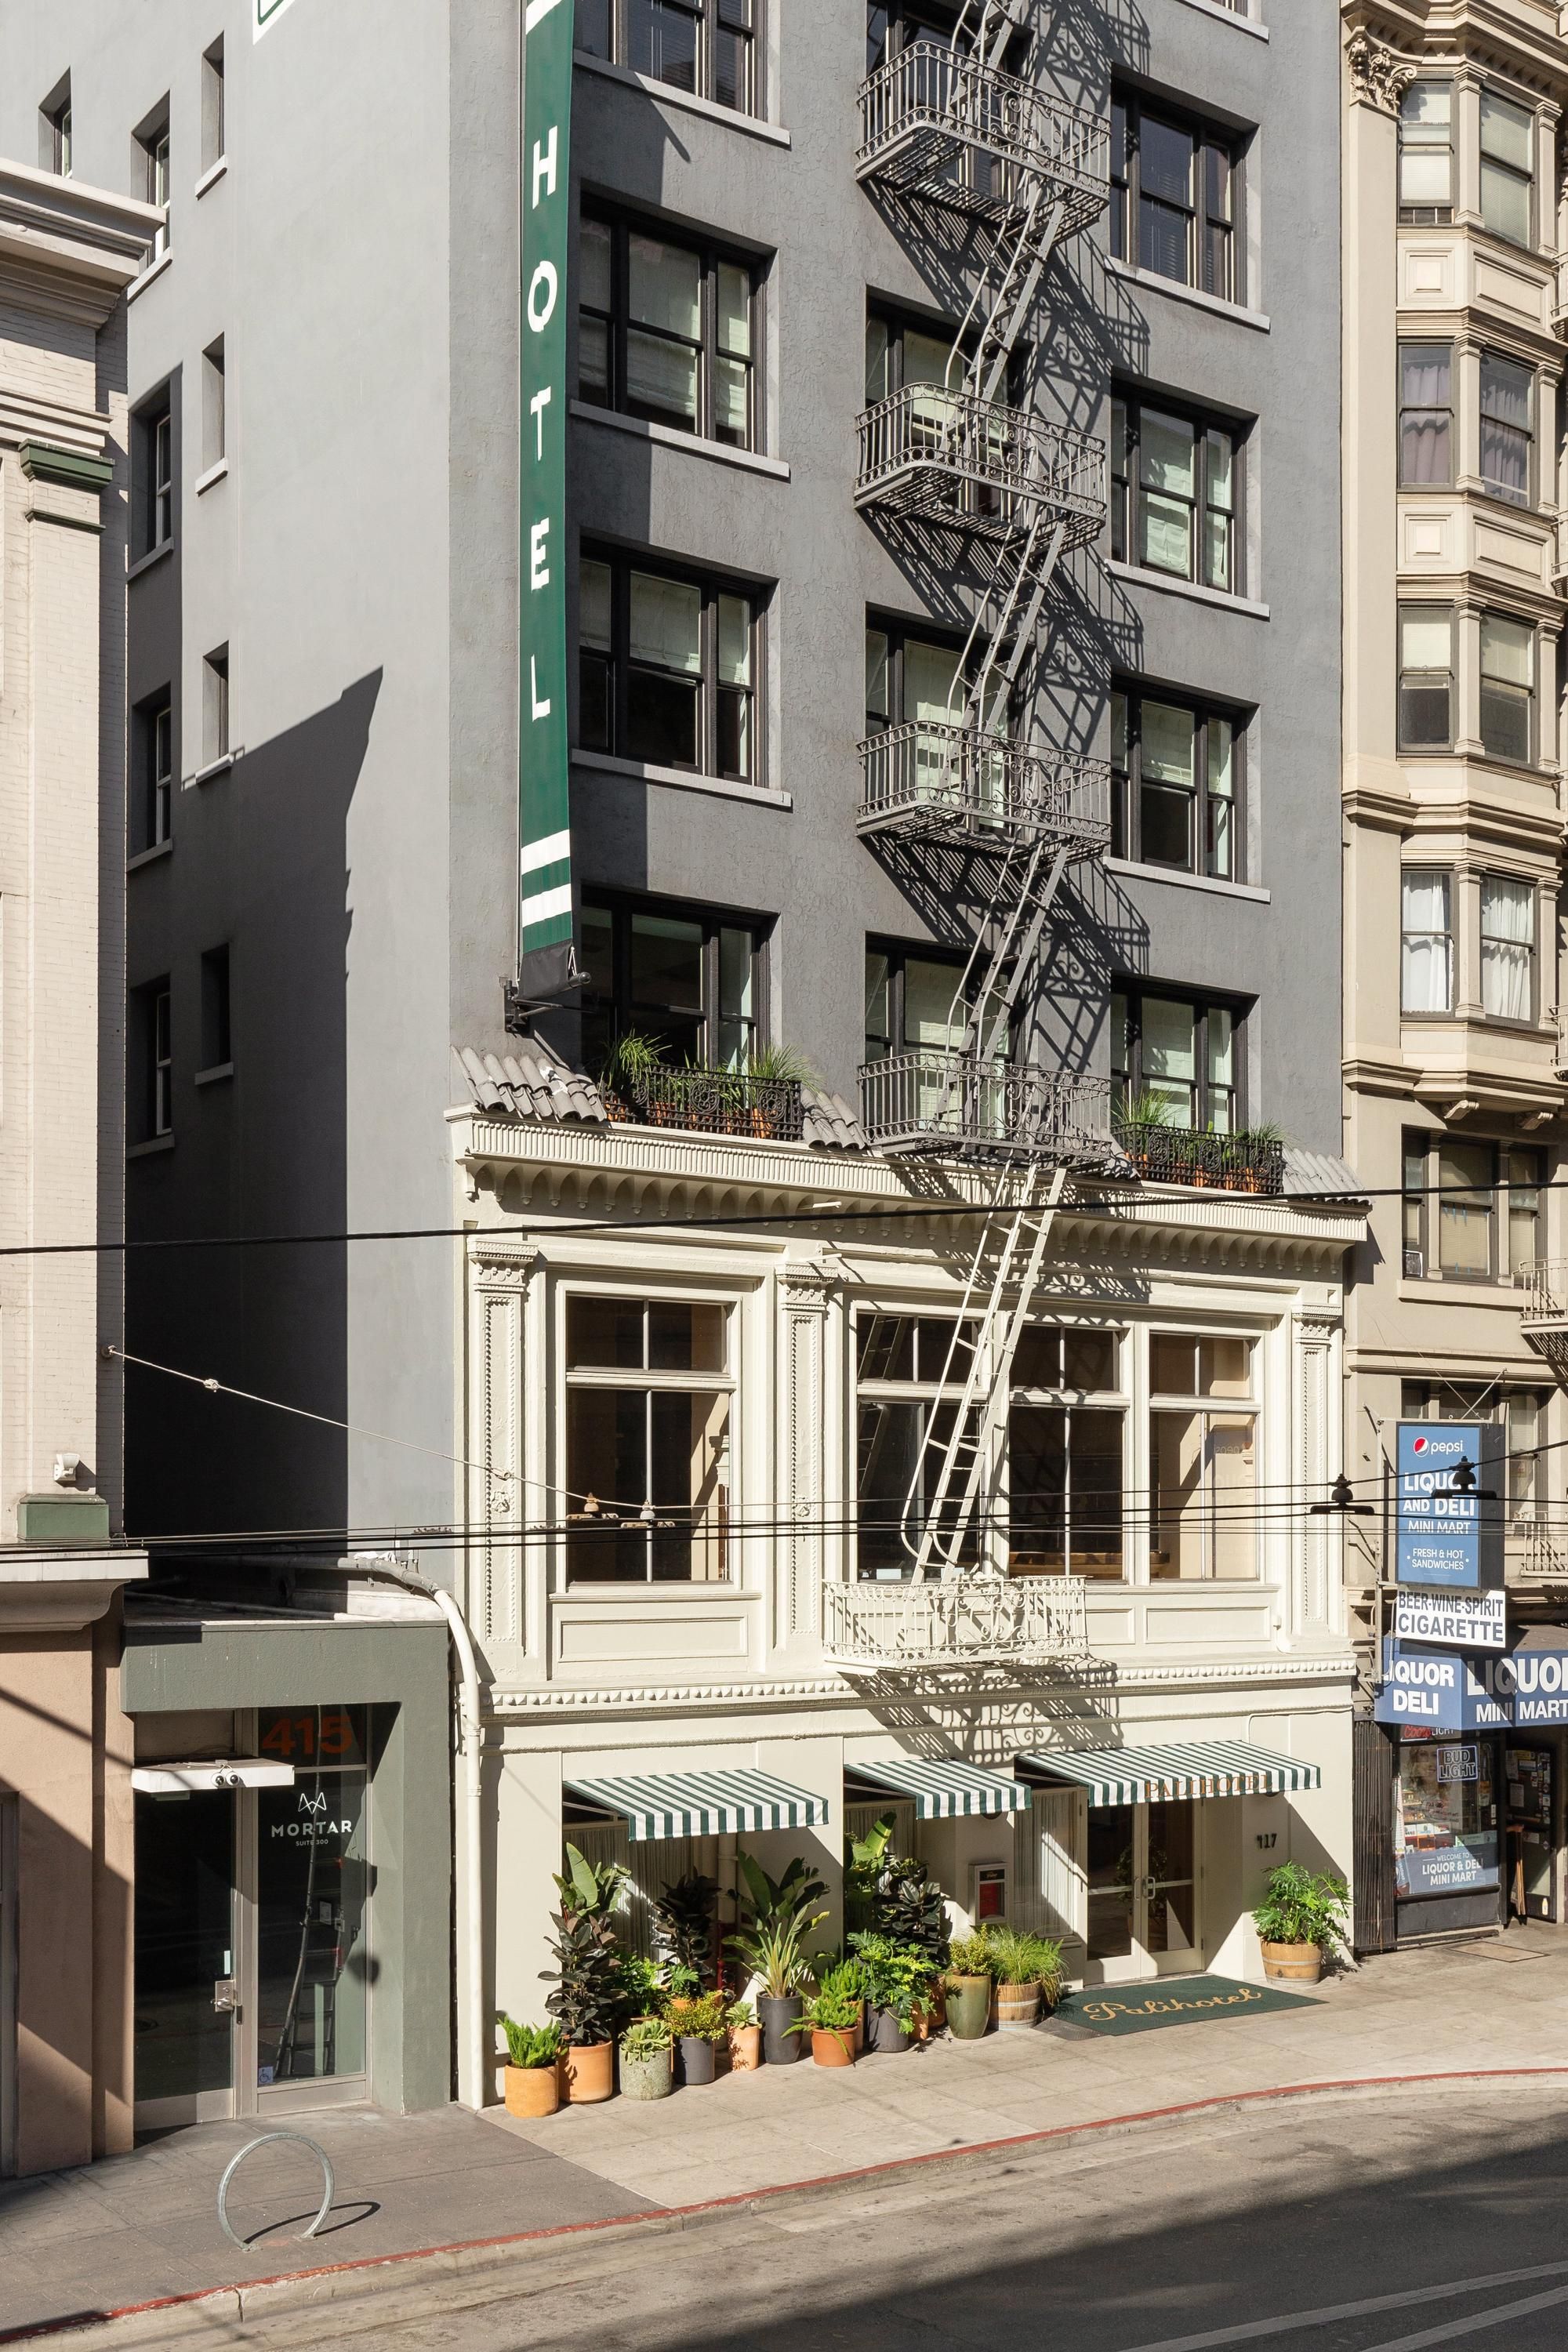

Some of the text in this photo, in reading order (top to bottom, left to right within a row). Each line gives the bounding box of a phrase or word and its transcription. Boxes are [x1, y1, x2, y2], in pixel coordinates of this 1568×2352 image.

[527, 125, 558, 722] HOTEL
[1431, 1440, 1463, 1455] pepsi
[1404, 1472, 1475, 1494] LIQUO
[1403, 1498, 1475, 1516] AND DELI
[1408, 1520, 1471, 1534] MINI MART
[1413, 1548, 1437, 1558] FRESH
[1446, 1549, 1465, 1559] HOT
[1412, 1559, 1465, 1570] SANDWICHES
[1398, 1613, 1504, 1642] CIGARETTE
[1393, 1689, 1439, 1715] DELI
[1476, 1699, 1568, 1722] MINI MART
[263, 1715, 353, 1756] 415
[1443, 1749, 1470, 1764] BUD
[1439, 1762, 1475, 1778] LIGHT
[271, 1820, 352, 1838] MORTAR
[1422, 1857, 1484, 1875] LIQUOR & DELI
[1430, 1871, 1477, 1886] MINI MART
[1083, 1988, 1261, 2020] Palihotel
